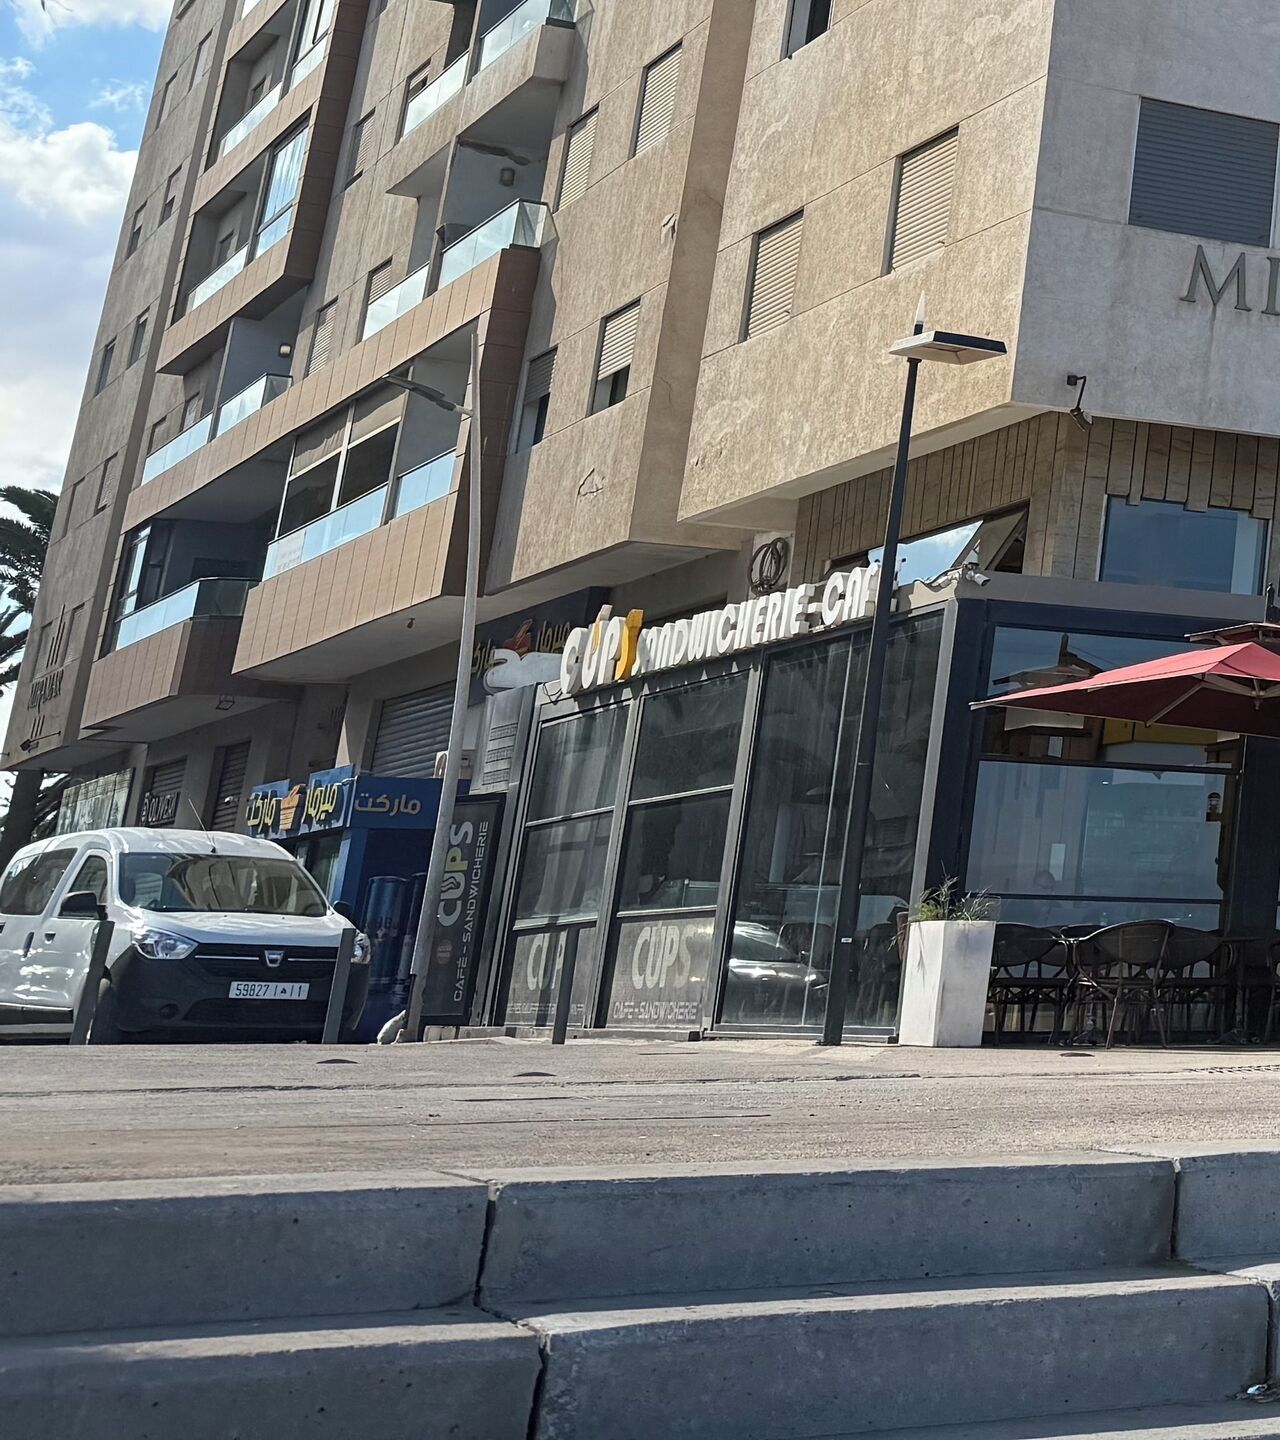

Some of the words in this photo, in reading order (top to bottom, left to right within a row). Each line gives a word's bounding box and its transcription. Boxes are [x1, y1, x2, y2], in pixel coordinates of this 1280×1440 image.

[561, 605, 644, 695] CUPS
[354, 793, 421, 817] ماركت
[437, 821, 474, 927] CUPS
[462, 821, 489, 943] SANDWICHERIE
[527, 928, 568, 991] CUP
[631, 920, 696, 989] CUPS
[235, 983, 270, 997] 59827
